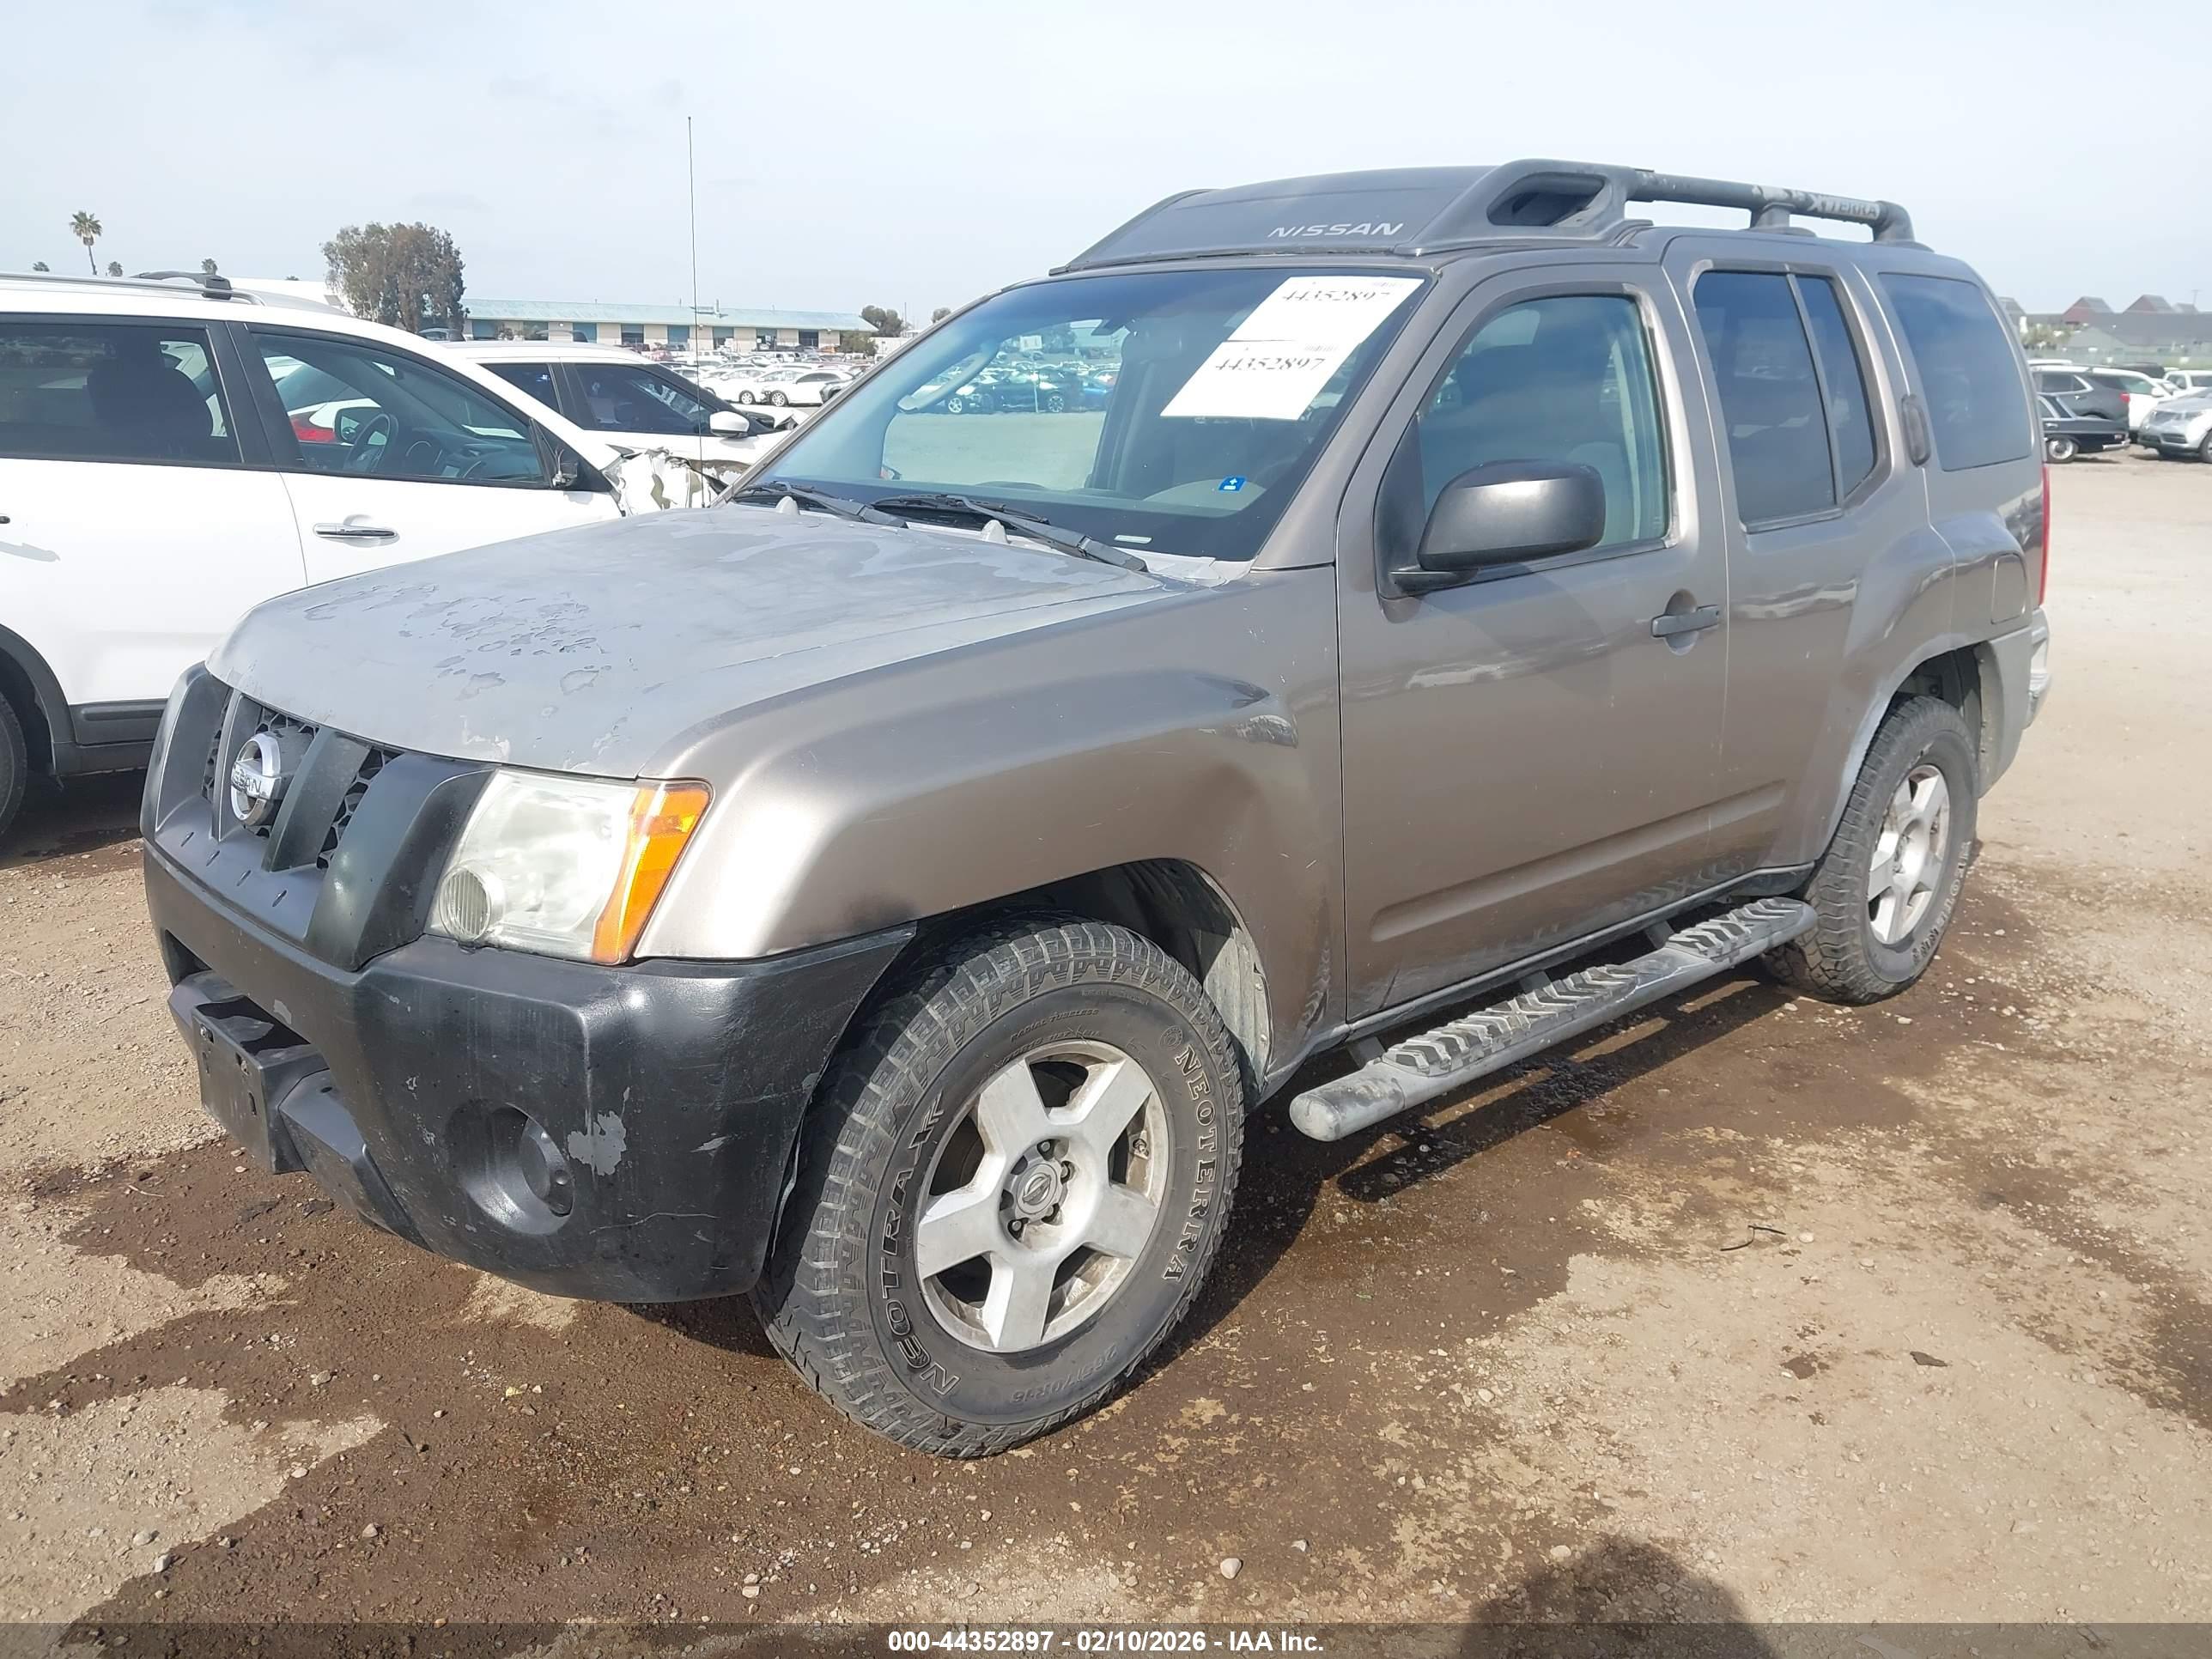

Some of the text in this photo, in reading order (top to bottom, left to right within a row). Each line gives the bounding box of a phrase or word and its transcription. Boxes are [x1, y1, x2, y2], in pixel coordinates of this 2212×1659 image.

[1267, 222, 1404, 238] NISSAN
[1282, 290, 1390, 301] 44352897
[1215, 357, 1325, 370] 44352897
[1162, 1043, 1218, 1282] NEOTERRA
